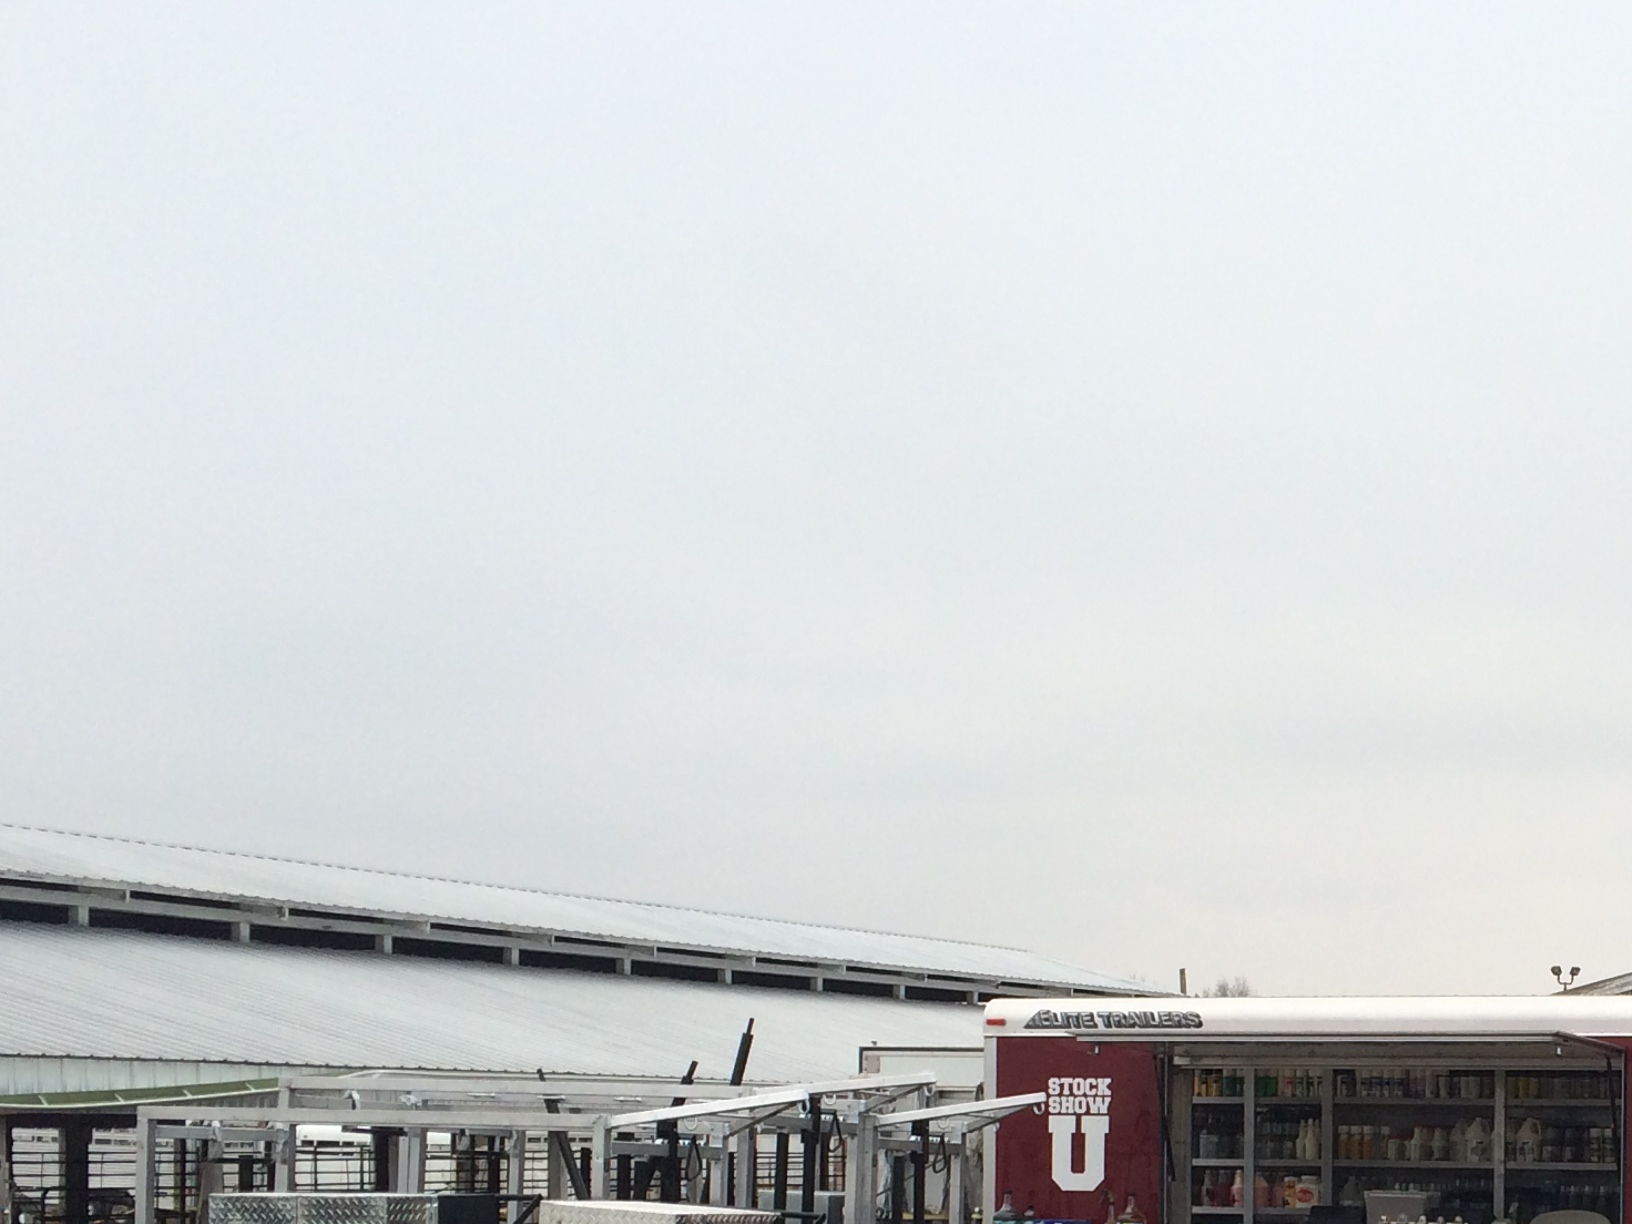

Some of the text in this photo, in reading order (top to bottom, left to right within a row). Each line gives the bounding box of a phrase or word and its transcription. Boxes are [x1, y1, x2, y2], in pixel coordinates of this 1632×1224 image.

[1026, 1010, 1203, 1029] ELITE TRAILERS
[1048, 1077, 1112, 1095] STOCK
[1048, 1096, 1112, 1114] SHOW
[1048, 1115, 1110, 1191] U
